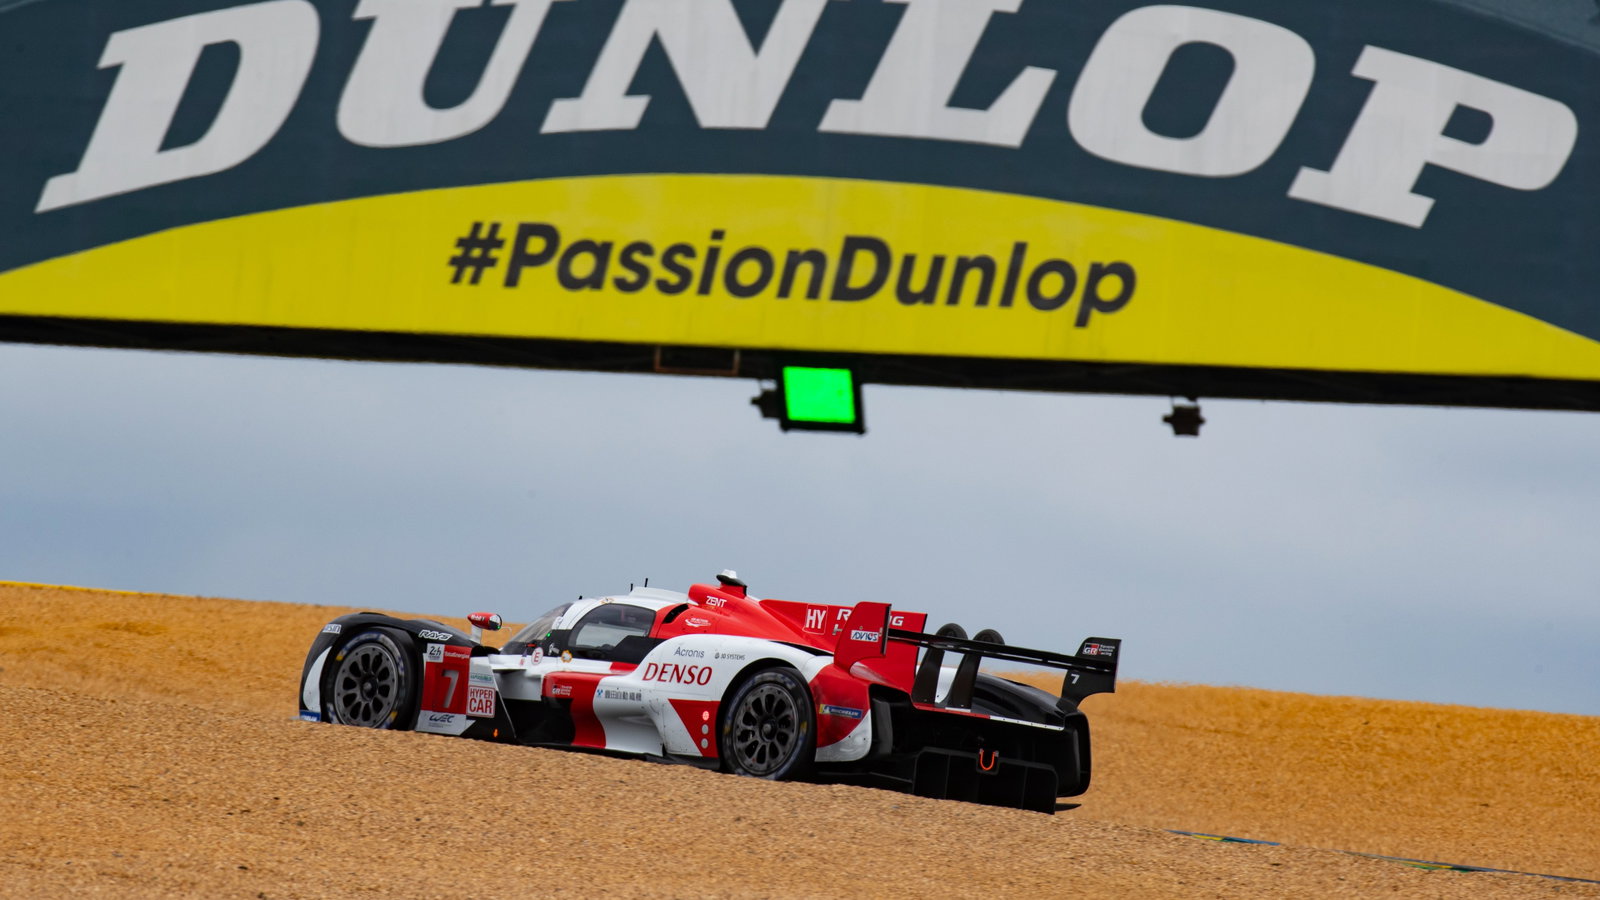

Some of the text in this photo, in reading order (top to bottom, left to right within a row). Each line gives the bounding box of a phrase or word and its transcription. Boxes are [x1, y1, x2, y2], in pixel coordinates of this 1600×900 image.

[35, 0, 1577, 228] DUNLOP
[447, 221, 1136, 328] #PassionDunlop
[706, 595, 727, 608] ZENT
[805, 608, 826, 629] HY
[419, 629, 453, 641] RAYS
[852, 631, 878, 641] ADVICS
[674, 646, 705, 658] Acronis
[1083, 647, 1097, 655] GR
[642, 662, 713, 686] DENSO
[1071, 673, 1080, 684] 7
[441, 669, 459, 709] 7
[470, 687, 493, 699] HYPER
[469, 698, 492, 714] CAR
[429, 714, 455, 723] WEC
